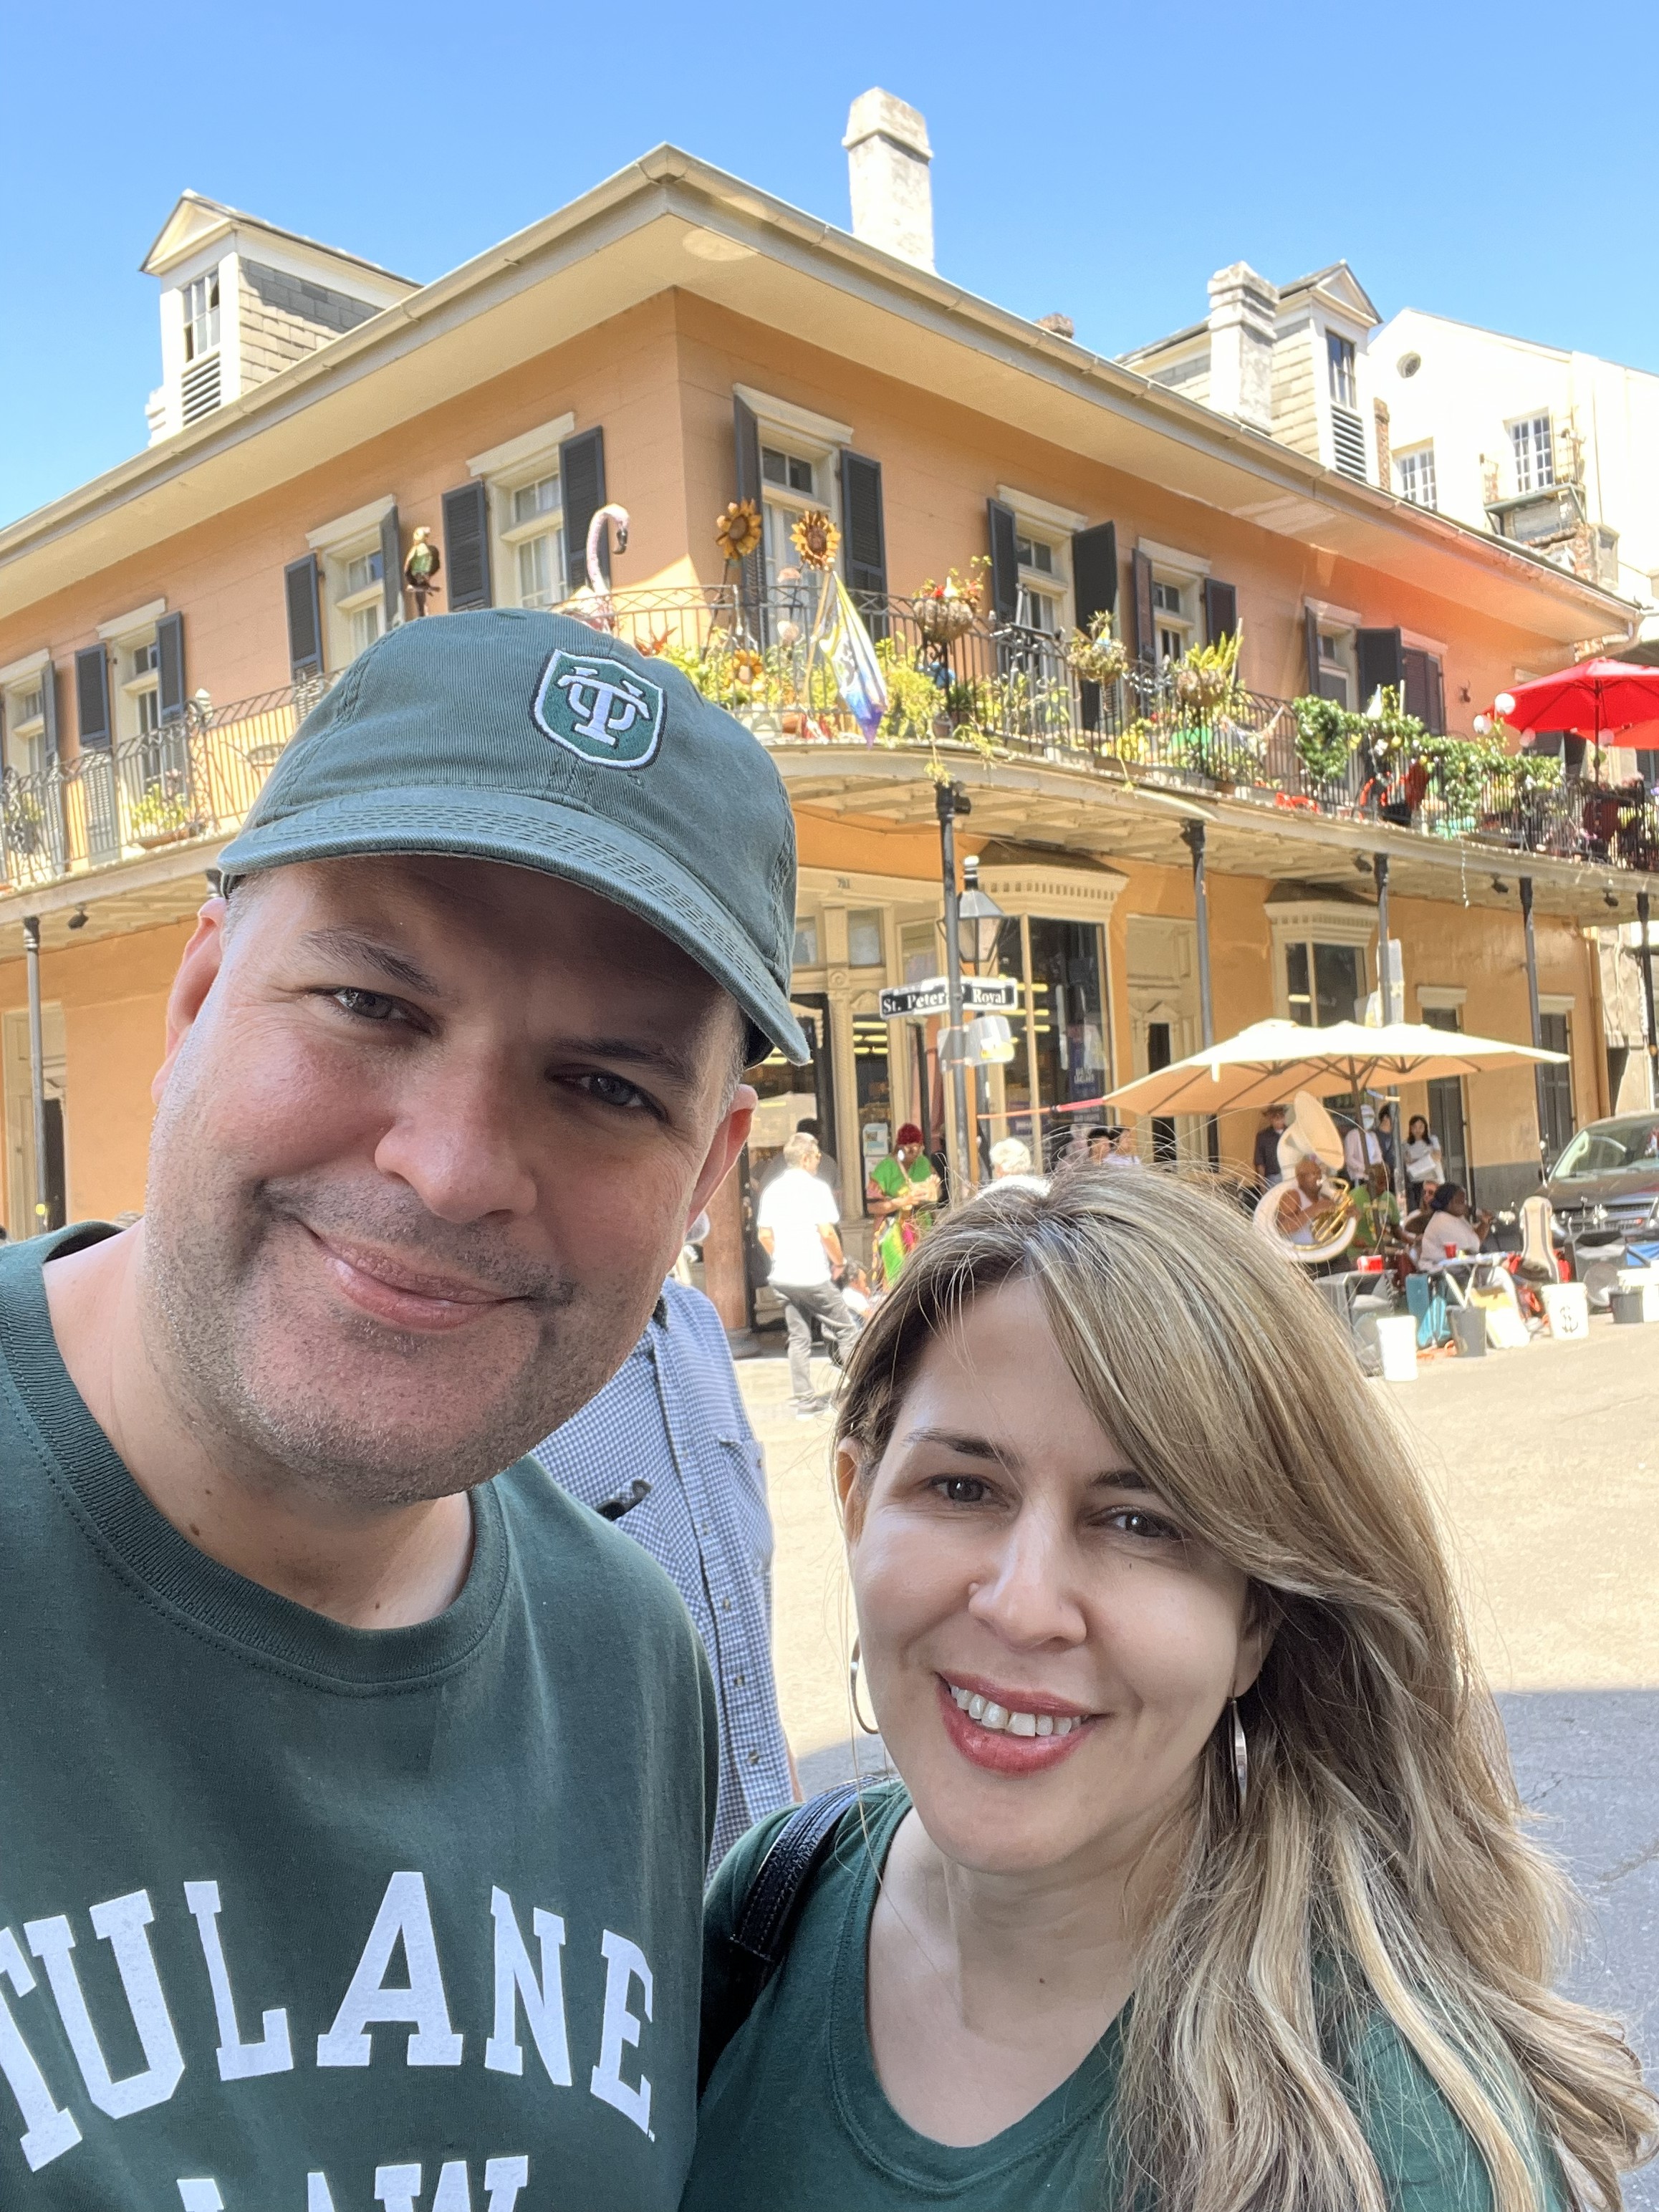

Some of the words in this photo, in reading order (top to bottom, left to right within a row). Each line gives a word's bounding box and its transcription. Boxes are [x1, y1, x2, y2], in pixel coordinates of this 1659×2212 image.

[883, 998, 901, 1014] St.
[907, 991, 946, 1009] Peter
[971, 987, 1006, 1006] Royal
[0, 1871, 653, 2171] TULANE
